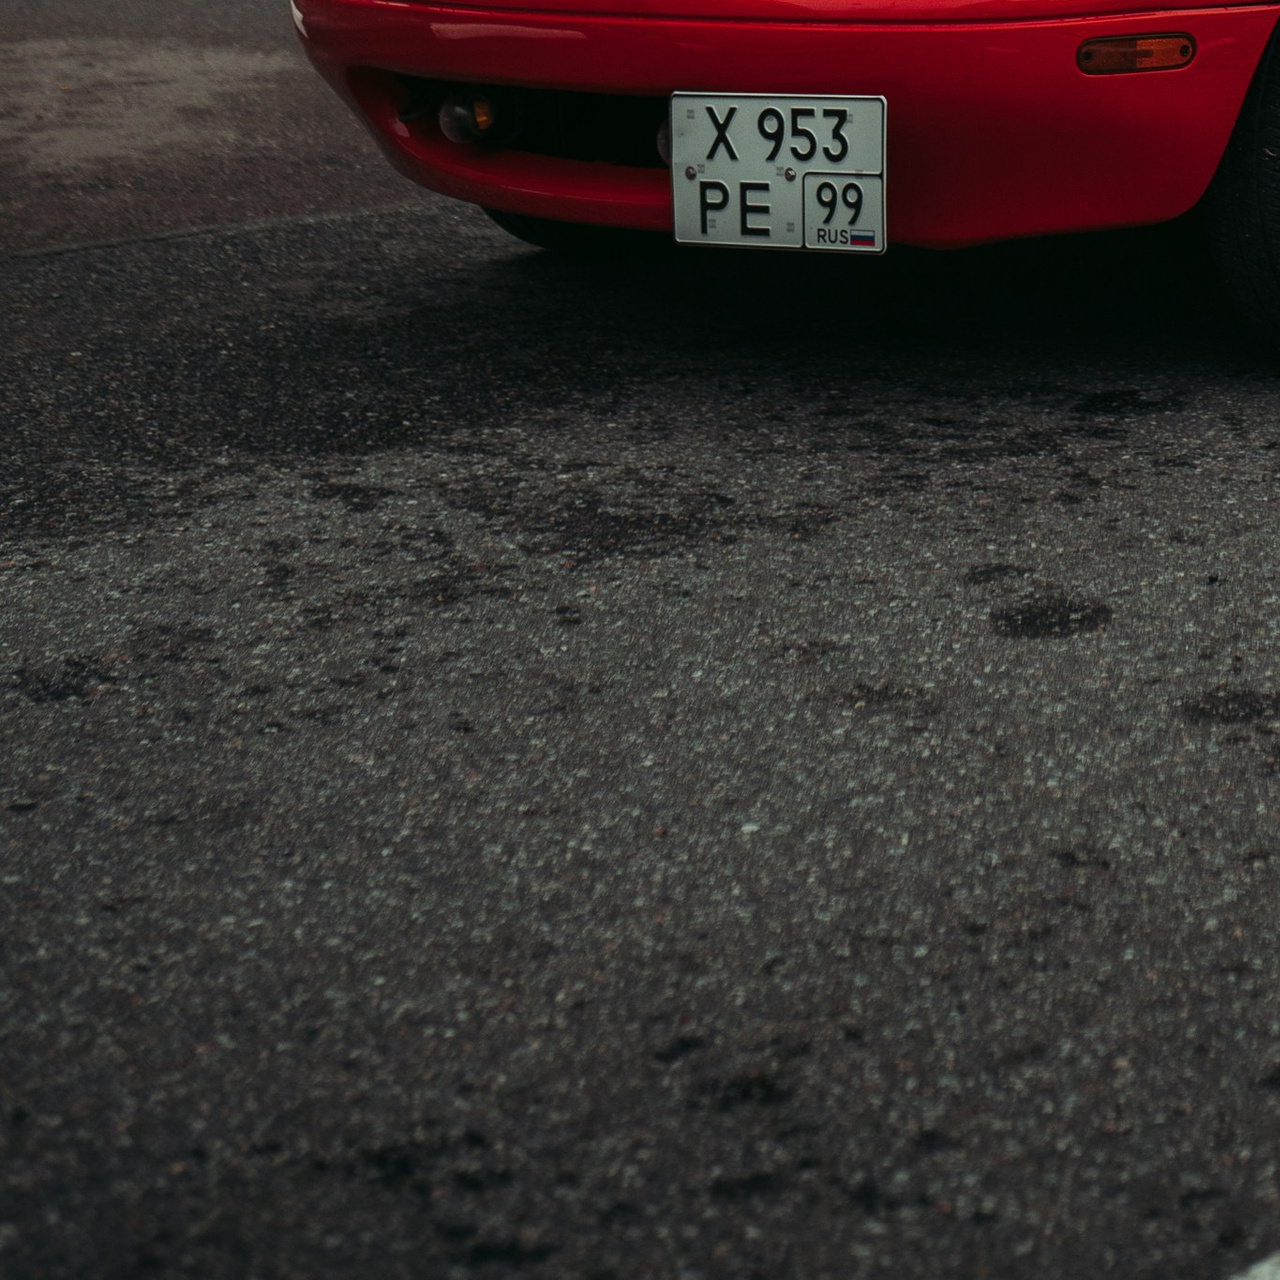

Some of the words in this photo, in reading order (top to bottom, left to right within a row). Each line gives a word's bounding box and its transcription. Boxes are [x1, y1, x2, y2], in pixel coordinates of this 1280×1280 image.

[757, 107, 849, 163] 953
[816, 181, 864, 225] 99
[817, 228, 849, 245] RUS
